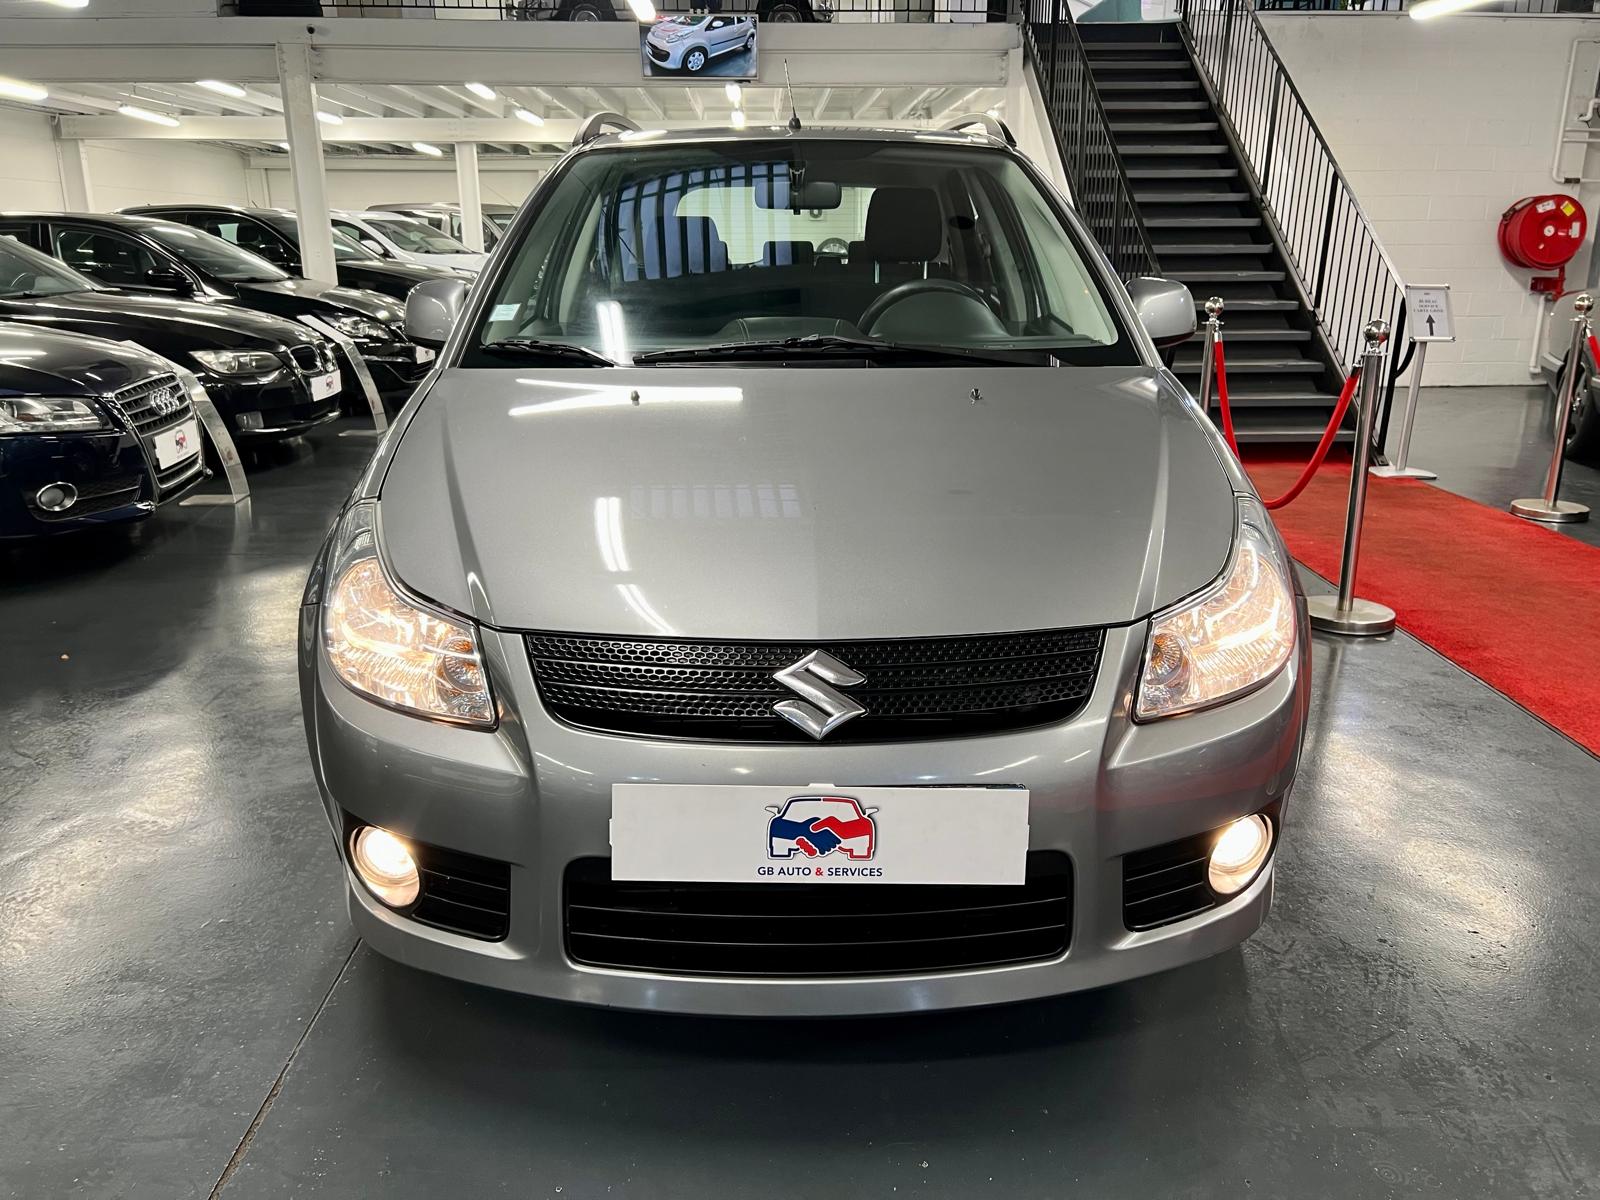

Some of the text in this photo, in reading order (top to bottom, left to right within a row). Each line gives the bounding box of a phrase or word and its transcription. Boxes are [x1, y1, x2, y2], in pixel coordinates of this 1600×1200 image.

[757, 866, 883, 877] GB AUTO & SERVICES
